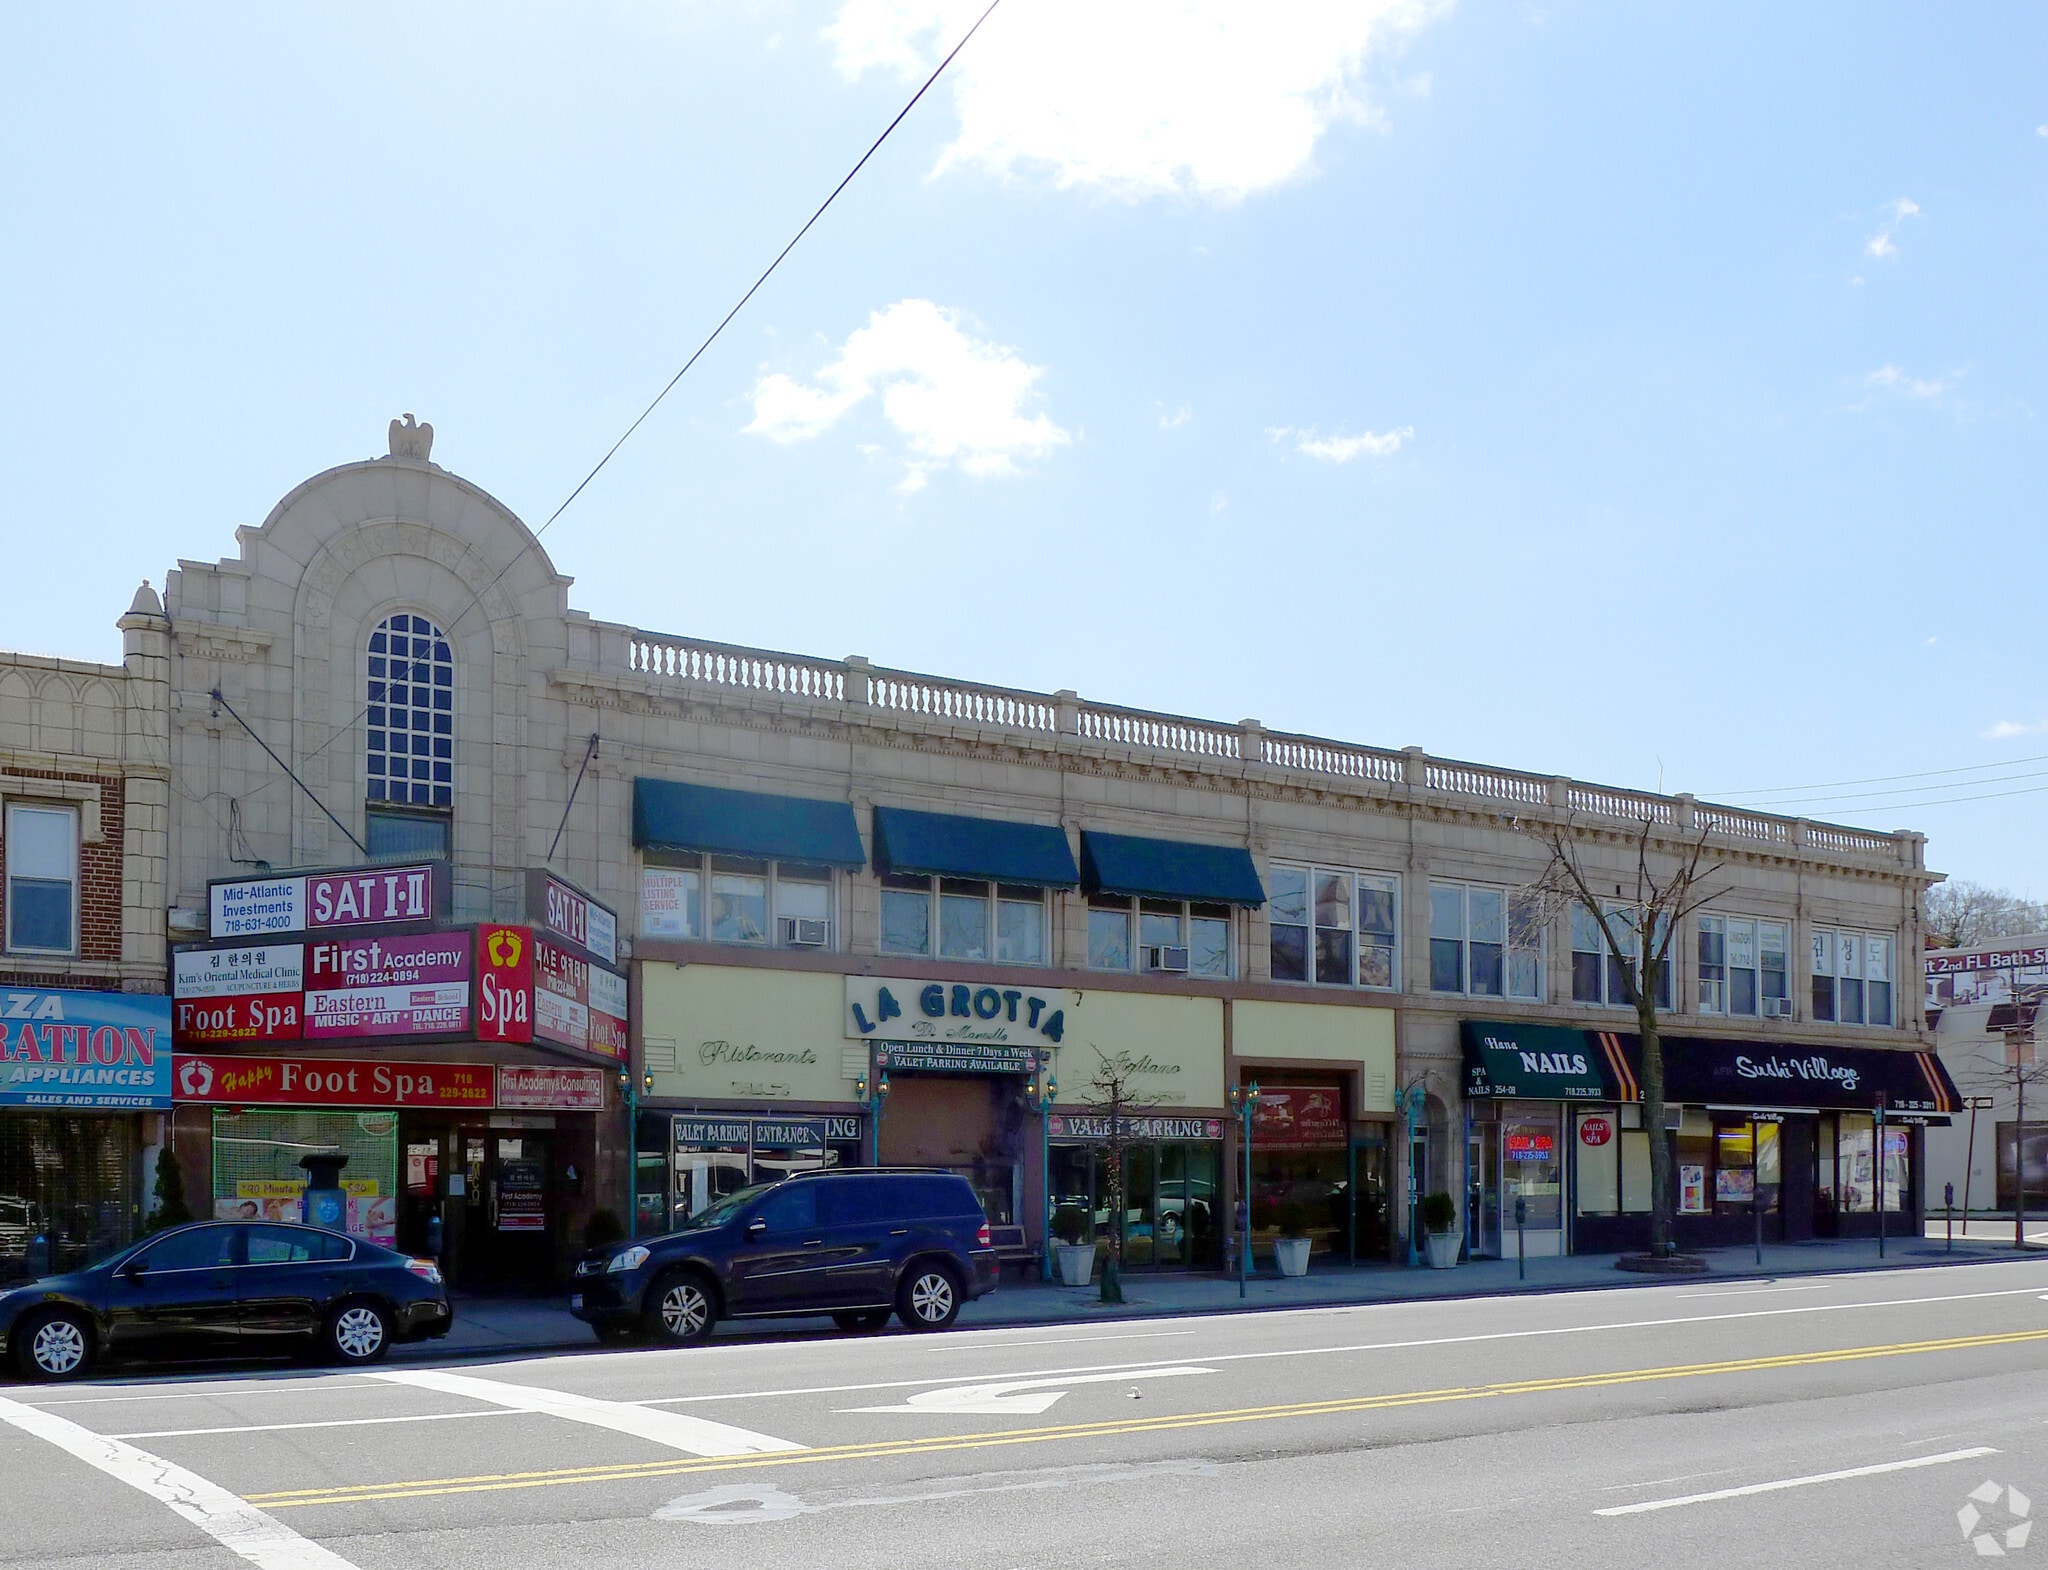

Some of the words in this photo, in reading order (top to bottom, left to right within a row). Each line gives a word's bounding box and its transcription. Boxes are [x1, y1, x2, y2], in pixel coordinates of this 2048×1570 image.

[643, 877, 683, 888] MULTIPLE
[223, 885, 293, 901] Mid-Atlantic
[314, 879, 375, 922] SAT
[643, 888, 675, 900] LISTING
[223, 901, 293, 917] Investments
[547, 885, 570, 933] SAT
[644, 899, 680, 911] SERVICE
[225, 916, 291, 933] 718-631-4000
[313, 942, 382, 974] First
[383, 949, 462, 972] Academy
[1938, 958, 1962, 972] 2nd
[1966, 955, 1986, 970] FL
[1990, 950, 2030, 968] Bath
[178, 972, 202, 984] Kim's
[204, 969, 238, 982] Oriental
[240, 967, 273, 980] Medical
[274, 965, 300, 978] Clinic
[226, 981, 271, 993] ACUPUNCTURE
[278, 980, 300, 989] HERBS
[314, 994, 386, 1013] Eastern
[481, 973, 528, 1036] Spa
[178, 1003, 236, 1031] Foot
[249, 1000, 298, 1035] Spa
[314, 1013, 360, 1028] MUSIC
[371, 1012, 400, 1025] ART
[412, 1008, 461, 1022] DANCE
[852, 986, 902, 1034] LA
[920, 983, 1065, 1043] GROTTA
[589, 1015, 608, 1045] Foot
[611, 1022, 627, 1055] Spa
[1484, 1037, 1518, 1051] Hana
[699, 1041, 817, 1066] Ristorante
[880, 1041, 904, 1054] Open
[906, 1042, 935, 1054] Lunch
[935, 1043, 945, 1054] &
[945, 1045, 976, 1055] Dinner
[977, 1046, 983, 1055] 7
[982, 1047, 1002, 1059] Days
[1010, 1048, 1034, 1058] Week
[893, 1056, 925, 1067] VALET
[926, 1057, 968, 1069] PARKING
[969, 1059, 1021, 1071] AVAILABLE
[1471, 1067, 1486, 1077] SPA
[1519, 1052, 1588, 1075] NAILS
[9, 1067, 155, 1086] APPLIANCES
[220, 1065, 273, 1092] Happy
[453, 1073, 472, 1085] 718
[502, 1073, 517, 1090] First
[1475, 1076, 1482, 1086] &
[1736, 1056, 1792, 1079] Sushi
[1790, 1058, 1861, 1090] Village
[279, 1063, 359, 1093] Foot
[373, 1066, 434, 1102] Spa
[1468, 1084, 1491, 1095] NAILS
[25, 1094, 63, 1104] SALES
[65, 1095, 96, 1105] AND
[96, 1096, 153, 1106] SERVICES
[439, 1087, 487, 1099] 229-2622
[675, 1123, 705, 1141] VALET
[707, 1124, 749, 1142] PARKING
[756, 1125, 810, 1143] ENTRANCE
[1129, 1118, 1202, 1137] PARKING
[1584, 1123, 1604, 1131] NAILS
[1586, 1135, 1601, 1143] SPA
[263, 1182, 294, 1193] Minute
